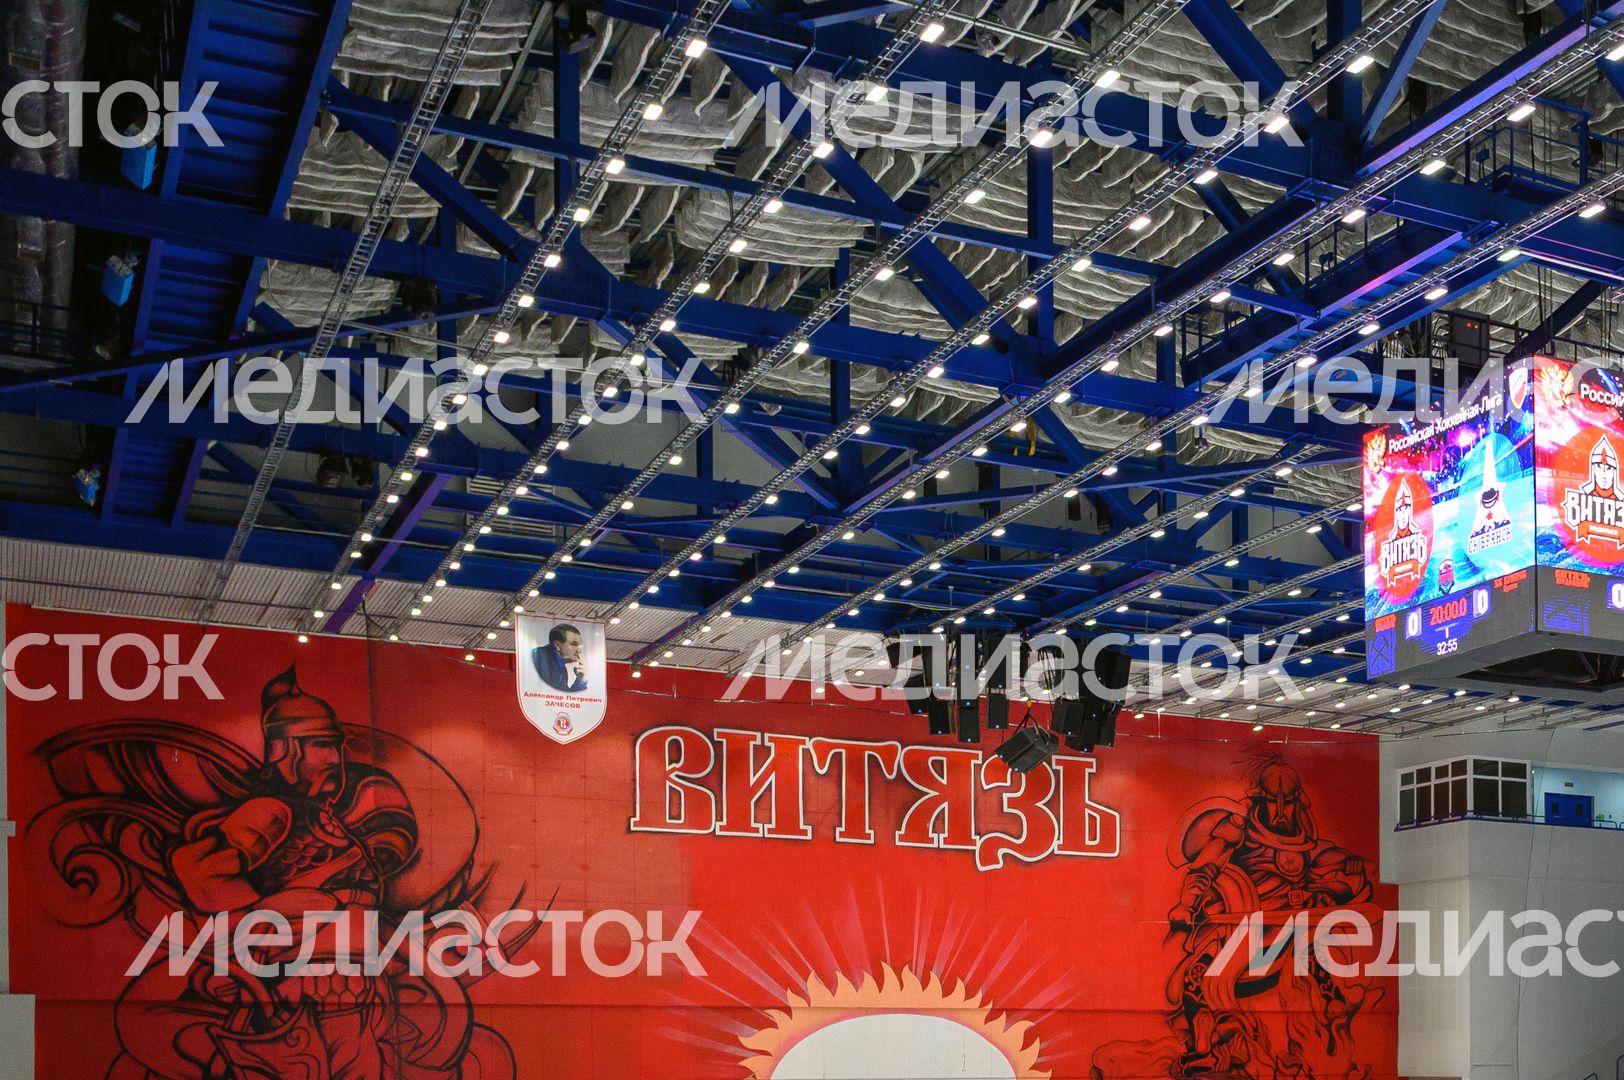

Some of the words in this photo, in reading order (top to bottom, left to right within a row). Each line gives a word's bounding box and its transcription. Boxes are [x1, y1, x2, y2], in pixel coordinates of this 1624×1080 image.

[1429, 598, 1468, 626] 20:00.0
[1477, 589, 1488, 614] 0
[1408, 612, 1418, 636] 0
[1436, 638, 1458, 656] 32:55
[630, 725, 1120, 871] ВИТЯЗЬ
